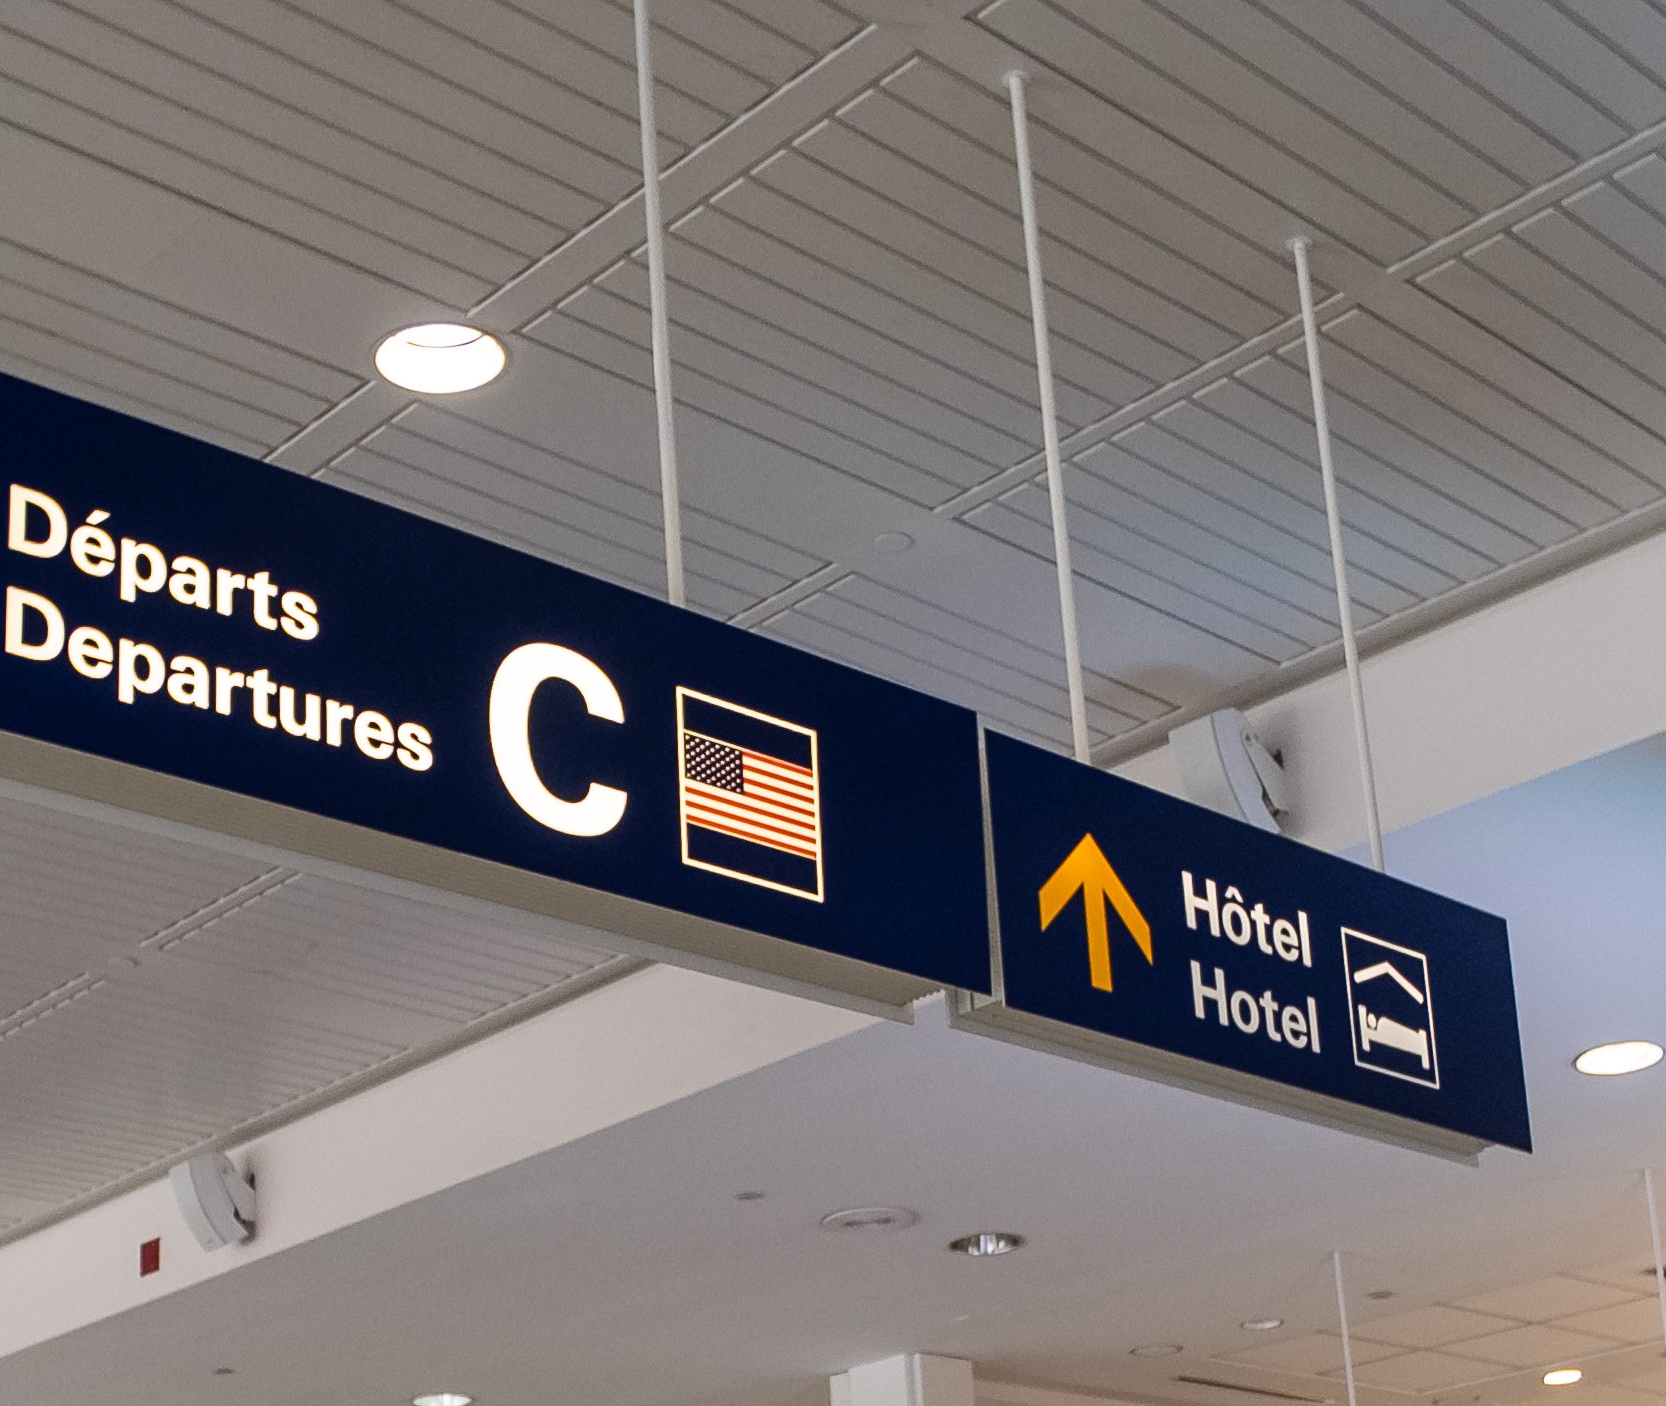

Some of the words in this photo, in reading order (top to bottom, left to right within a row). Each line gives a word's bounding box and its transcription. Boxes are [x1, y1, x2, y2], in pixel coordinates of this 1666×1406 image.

[6, 484, 320, 641] Départs
[5, 586, 434, 772] Departures
[489, 643, 628, 837] C
[1181, 870, 1312, 968] Hôtel
[1190, 960, 1321, 1053] Hotel
